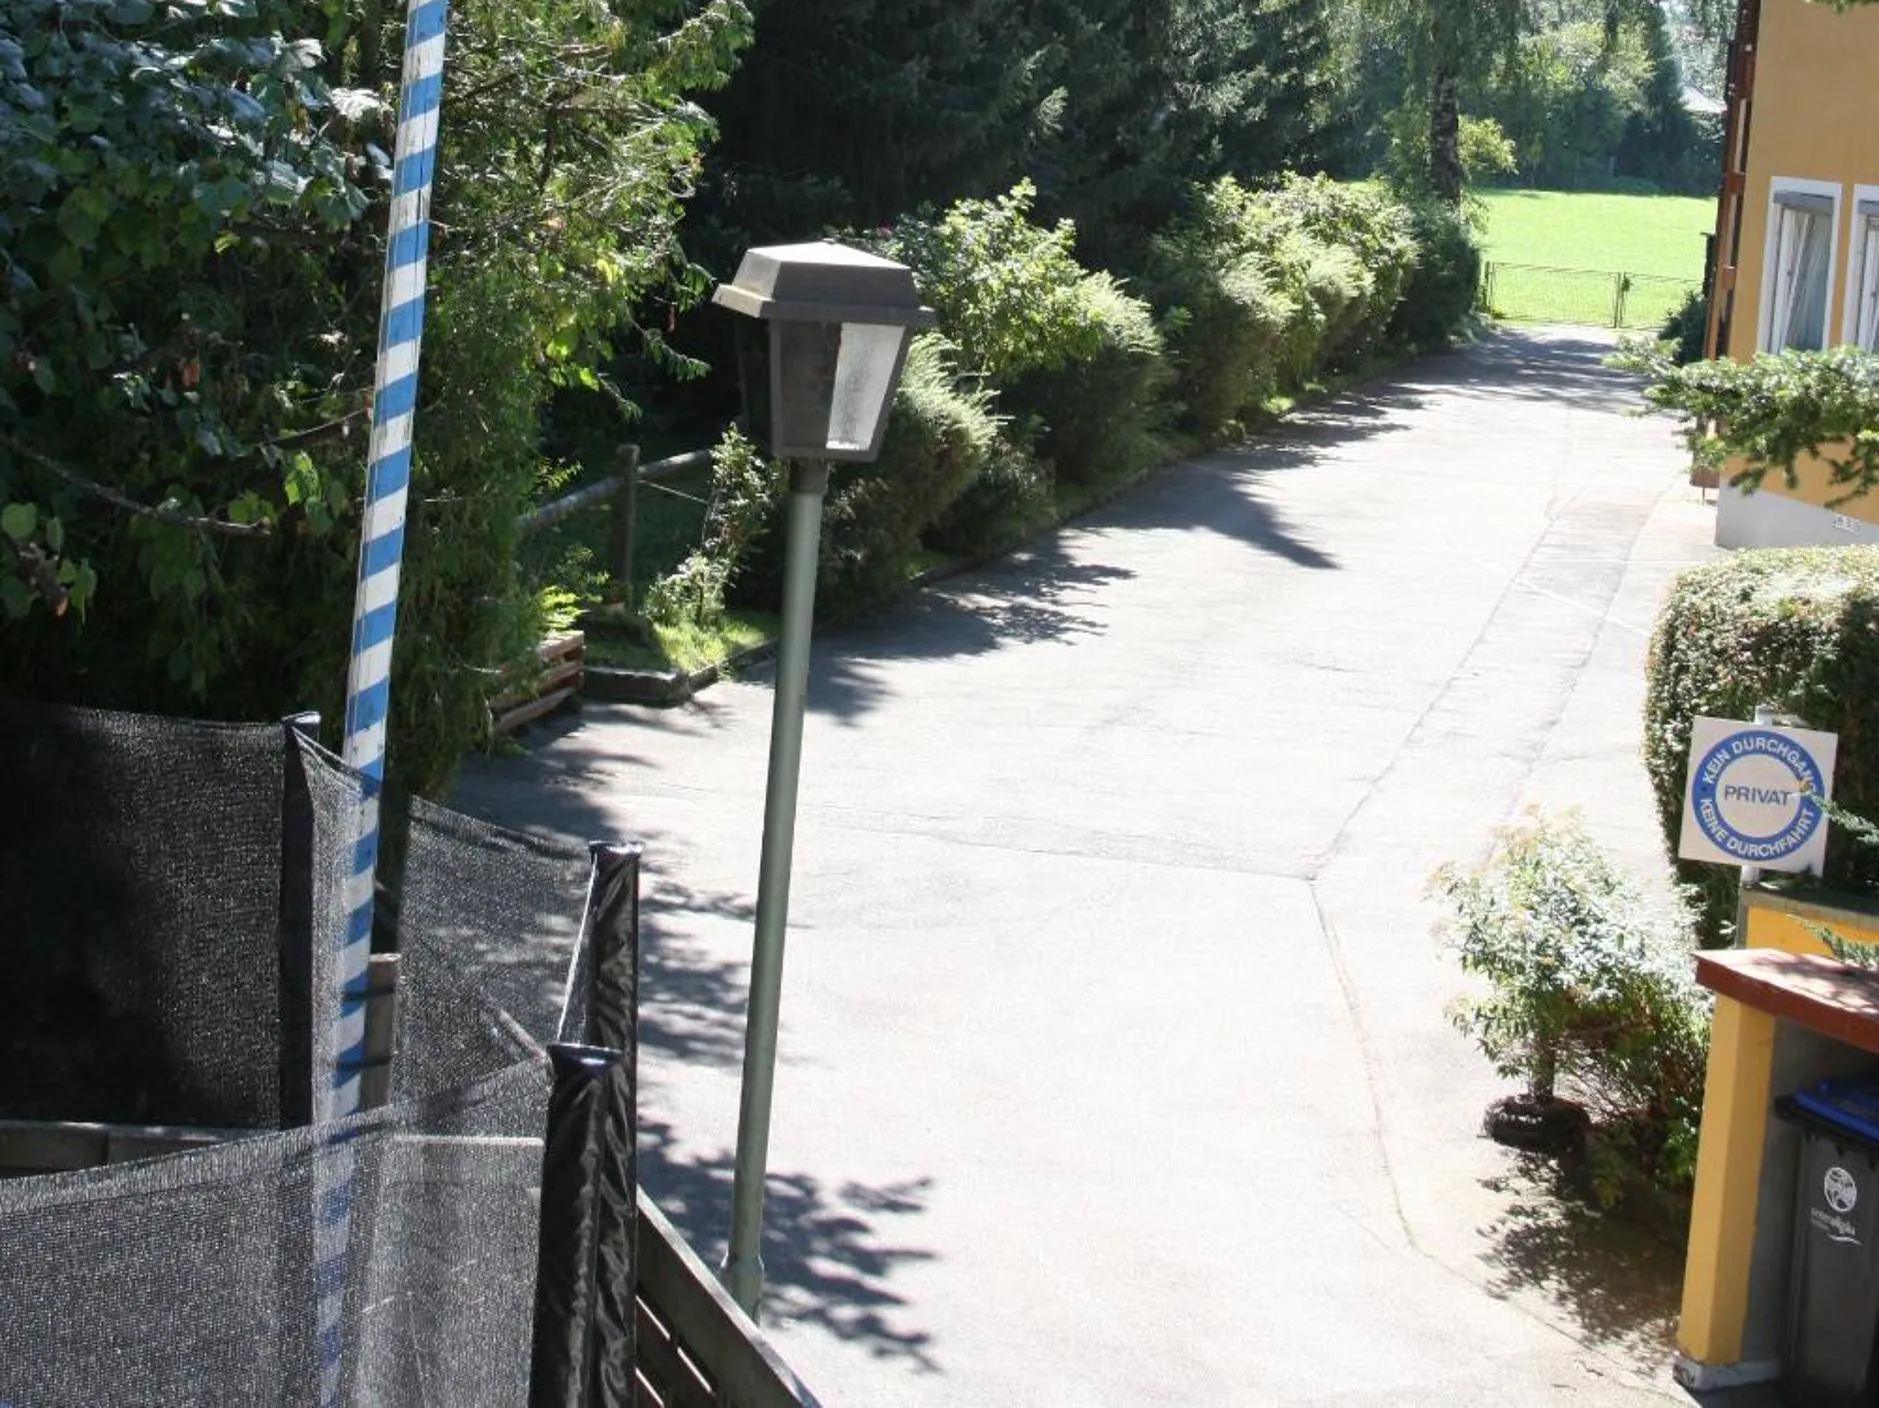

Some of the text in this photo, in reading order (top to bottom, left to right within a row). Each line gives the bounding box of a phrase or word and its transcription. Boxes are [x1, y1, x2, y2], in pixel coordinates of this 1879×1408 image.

[1702, 749, 1731, 784] KEIN
[1724, 784, 1792, 806] PRIVAT
[1700, 798, 1815, 858] KEINE DURCHFAHRT
